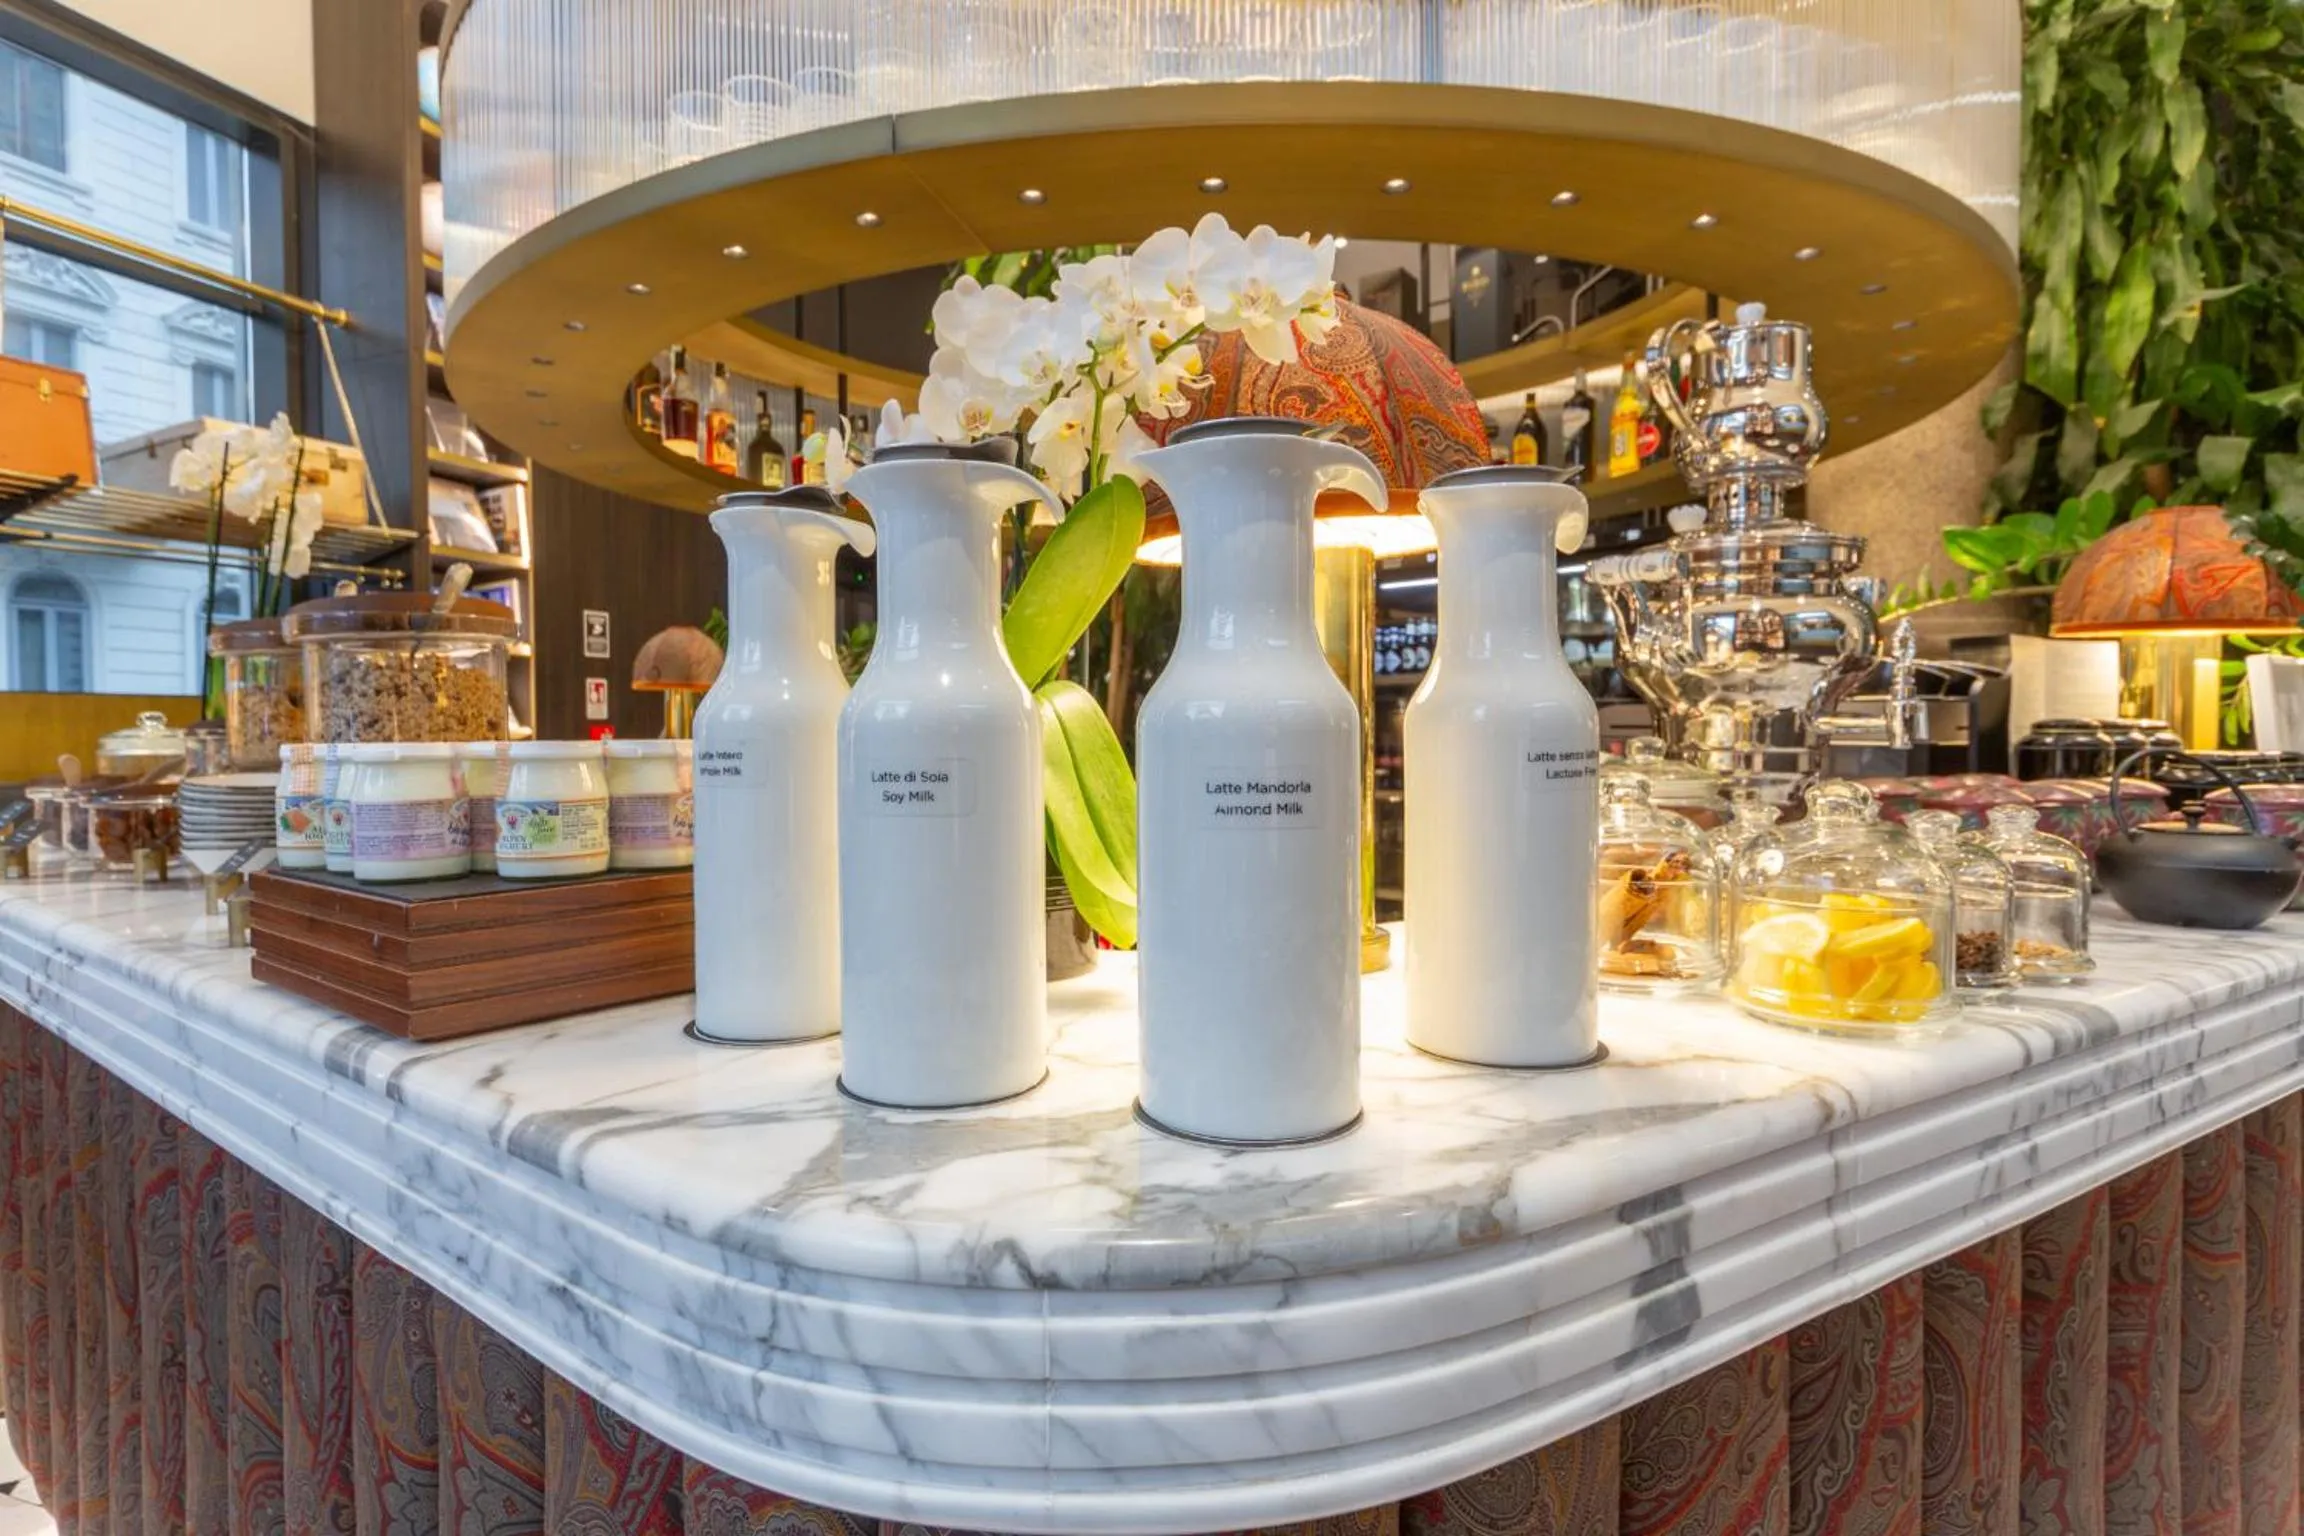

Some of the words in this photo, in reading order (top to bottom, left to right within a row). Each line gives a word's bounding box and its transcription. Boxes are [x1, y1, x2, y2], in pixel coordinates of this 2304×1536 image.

[1527, 752, 1557, 762] Latte
[722, 766, 742, 776] Milk
[871, 771, 901, 783] Latte
[904, 771, 917, 783] di
[920, 771, 949, 783] Soia
[1546, 768, 1583, 779] Lactose
[1205, 781, 1242, 794] Latte
[1246, 781, 1312, 794] Mandorla
[881, 790, 905, 805] Soy
[908, 790, 935, 802] Milk
[1214, 803, 1272, 816] Almond
[1276, 802, 1304, 815] Milk
